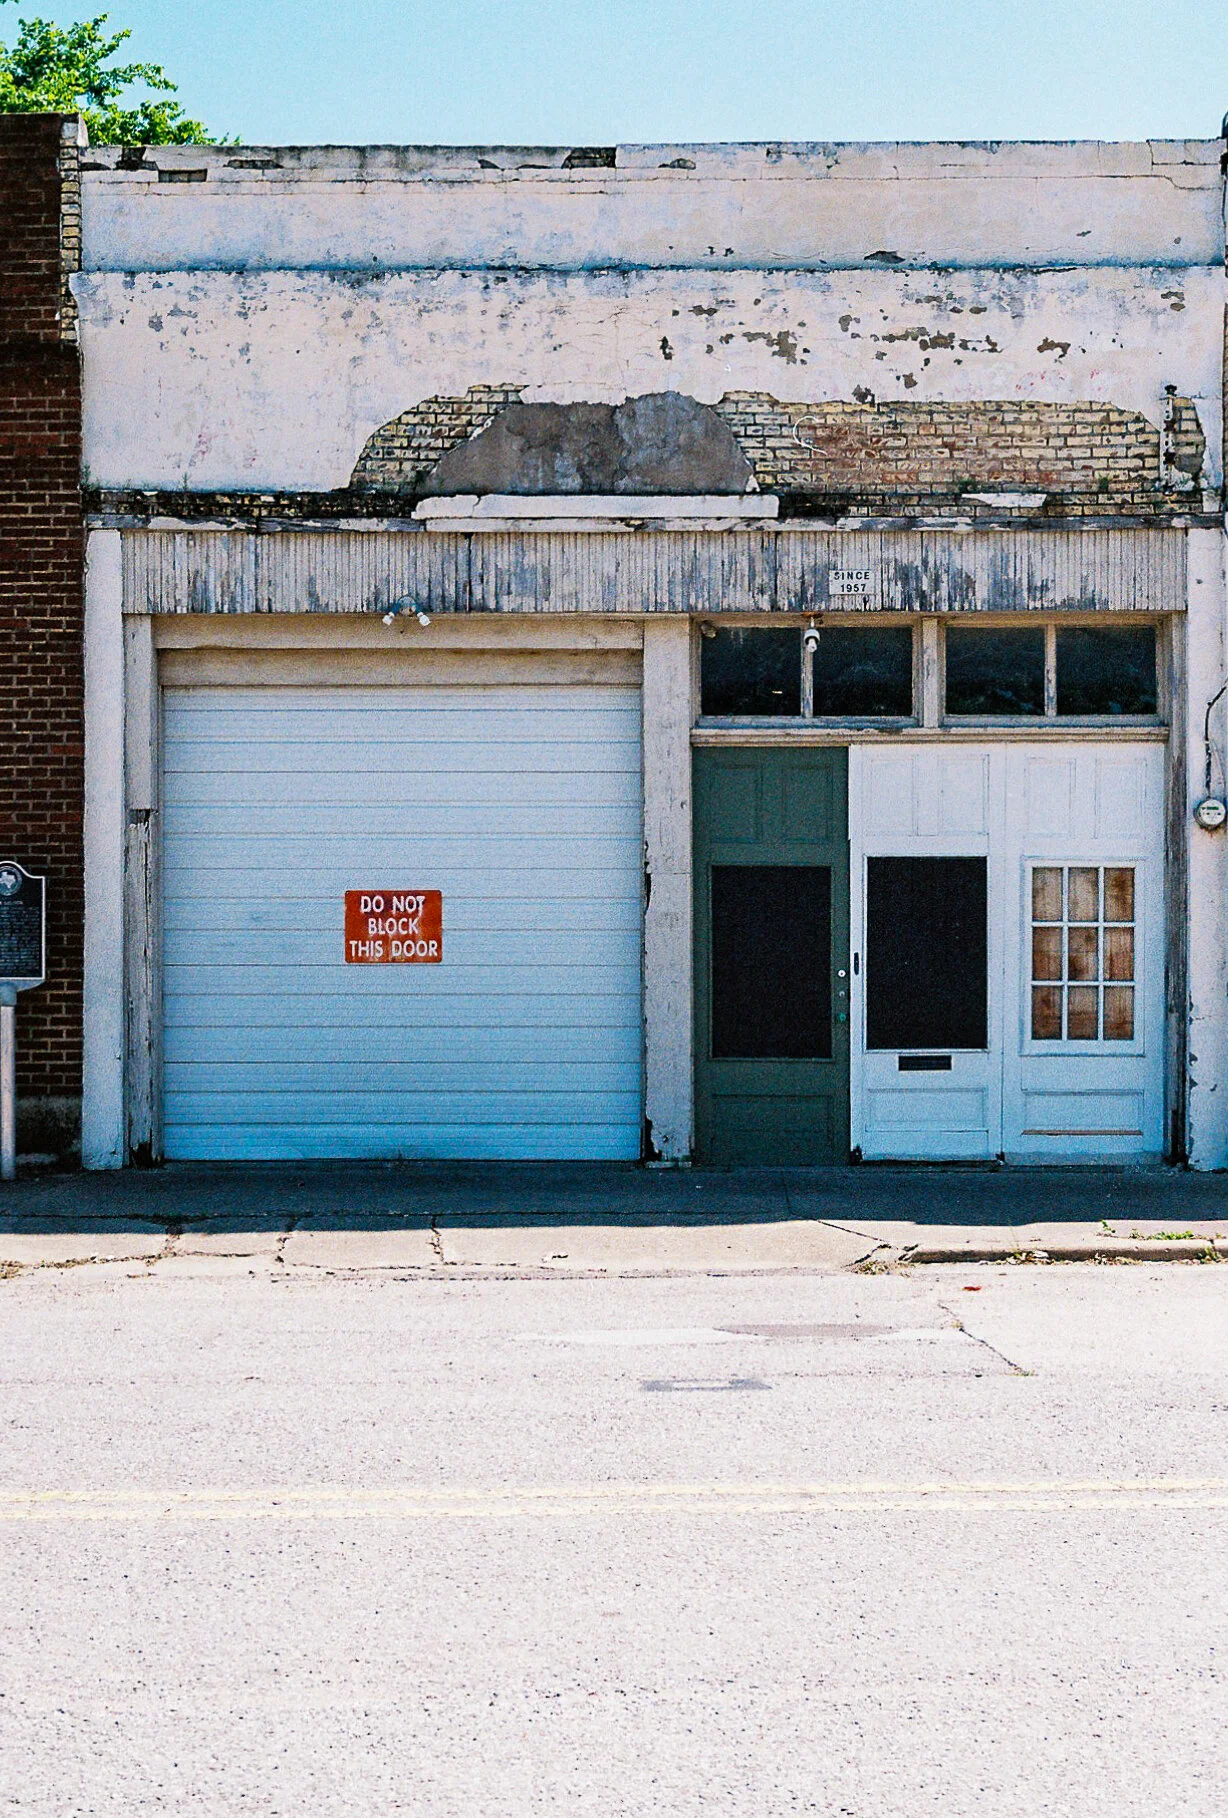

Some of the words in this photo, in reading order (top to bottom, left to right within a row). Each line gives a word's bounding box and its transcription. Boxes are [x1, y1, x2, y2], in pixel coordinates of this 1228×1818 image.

[834, 571, 870, 580] SINCE
[841, 583, 866, 593] 1957
[360, 895, 384, 913] DO
[392, 895, 426, 914] NOT
[368, 917, 420, 935] BLOCK
[349, 940, 384, 957] THIS
[391, 940, 438, 957] DOOR
